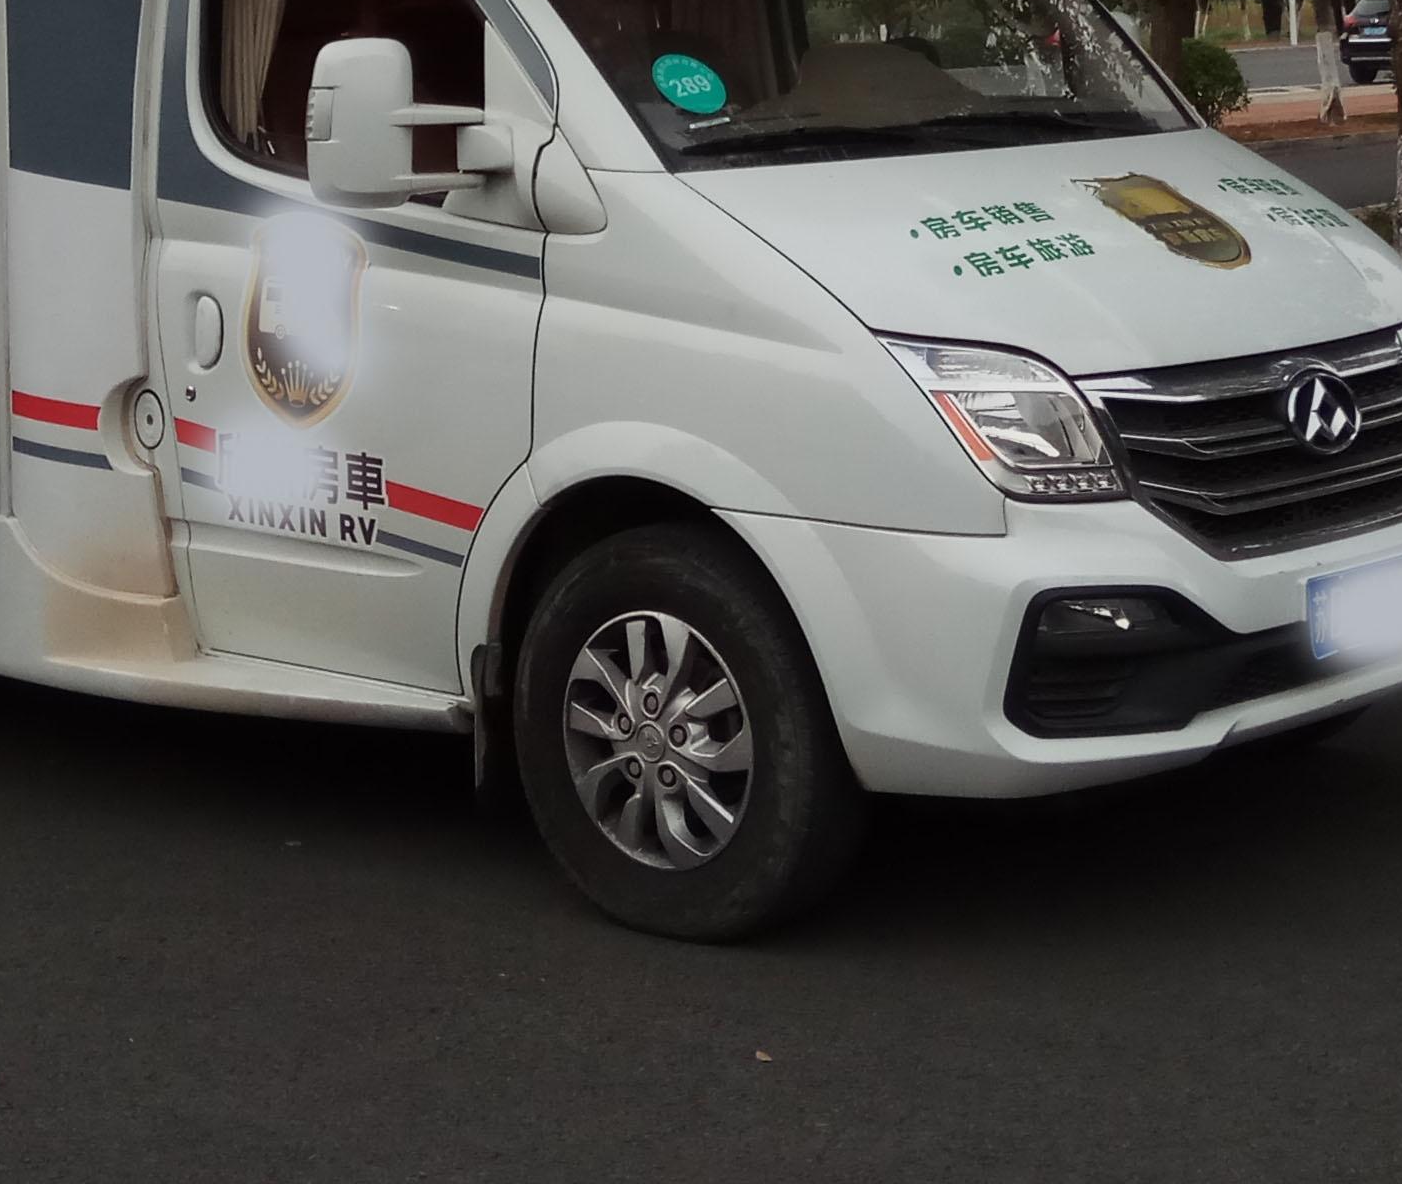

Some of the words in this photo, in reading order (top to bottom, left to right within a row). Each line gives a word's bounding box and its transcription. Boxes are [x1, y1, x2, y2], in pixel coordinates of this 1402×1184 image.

[669, 74, 711, 97] 289
[919, 202, 1055, 240] 房车销售
[963, 233, 1095, 277] 房车旅游
[228, 495, 327, 537] XINXIN
[339, 513, 377, 546] RV
